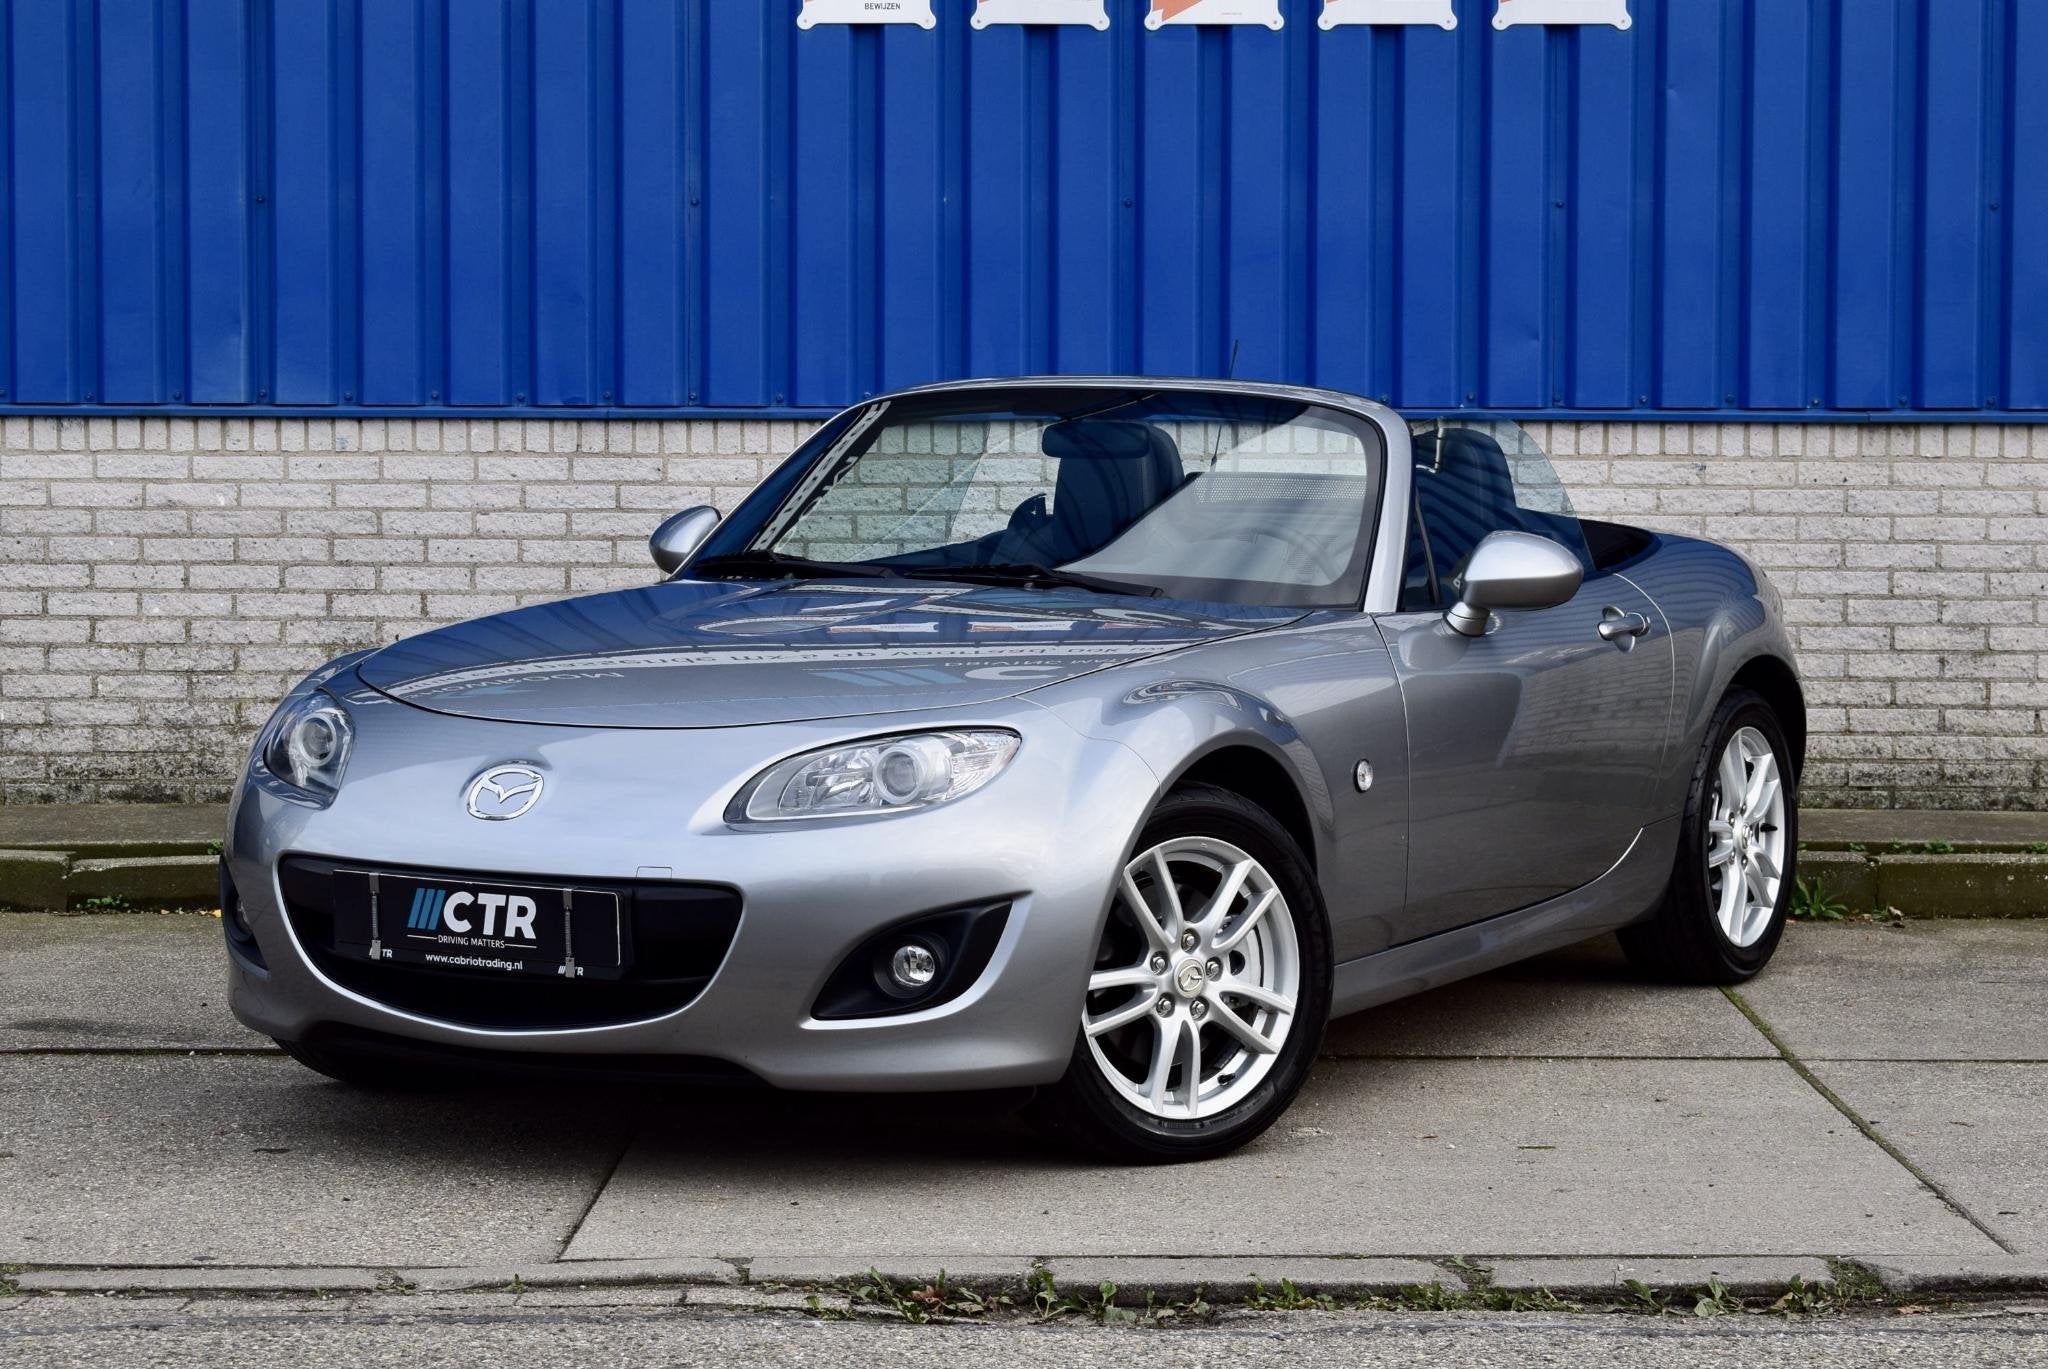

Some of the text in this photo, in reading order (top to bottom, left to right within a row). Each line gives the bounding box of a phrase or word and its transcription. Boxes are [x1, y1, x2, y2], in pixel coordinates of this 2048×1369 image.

[864, 2, 901, 10] BEWIJZEN
[443, 891, 537, 940] CTR
[437, 934, 506, 949] DRIVING MATTERS
[425, 953, 523, 971] www.cabriotrading.nl
